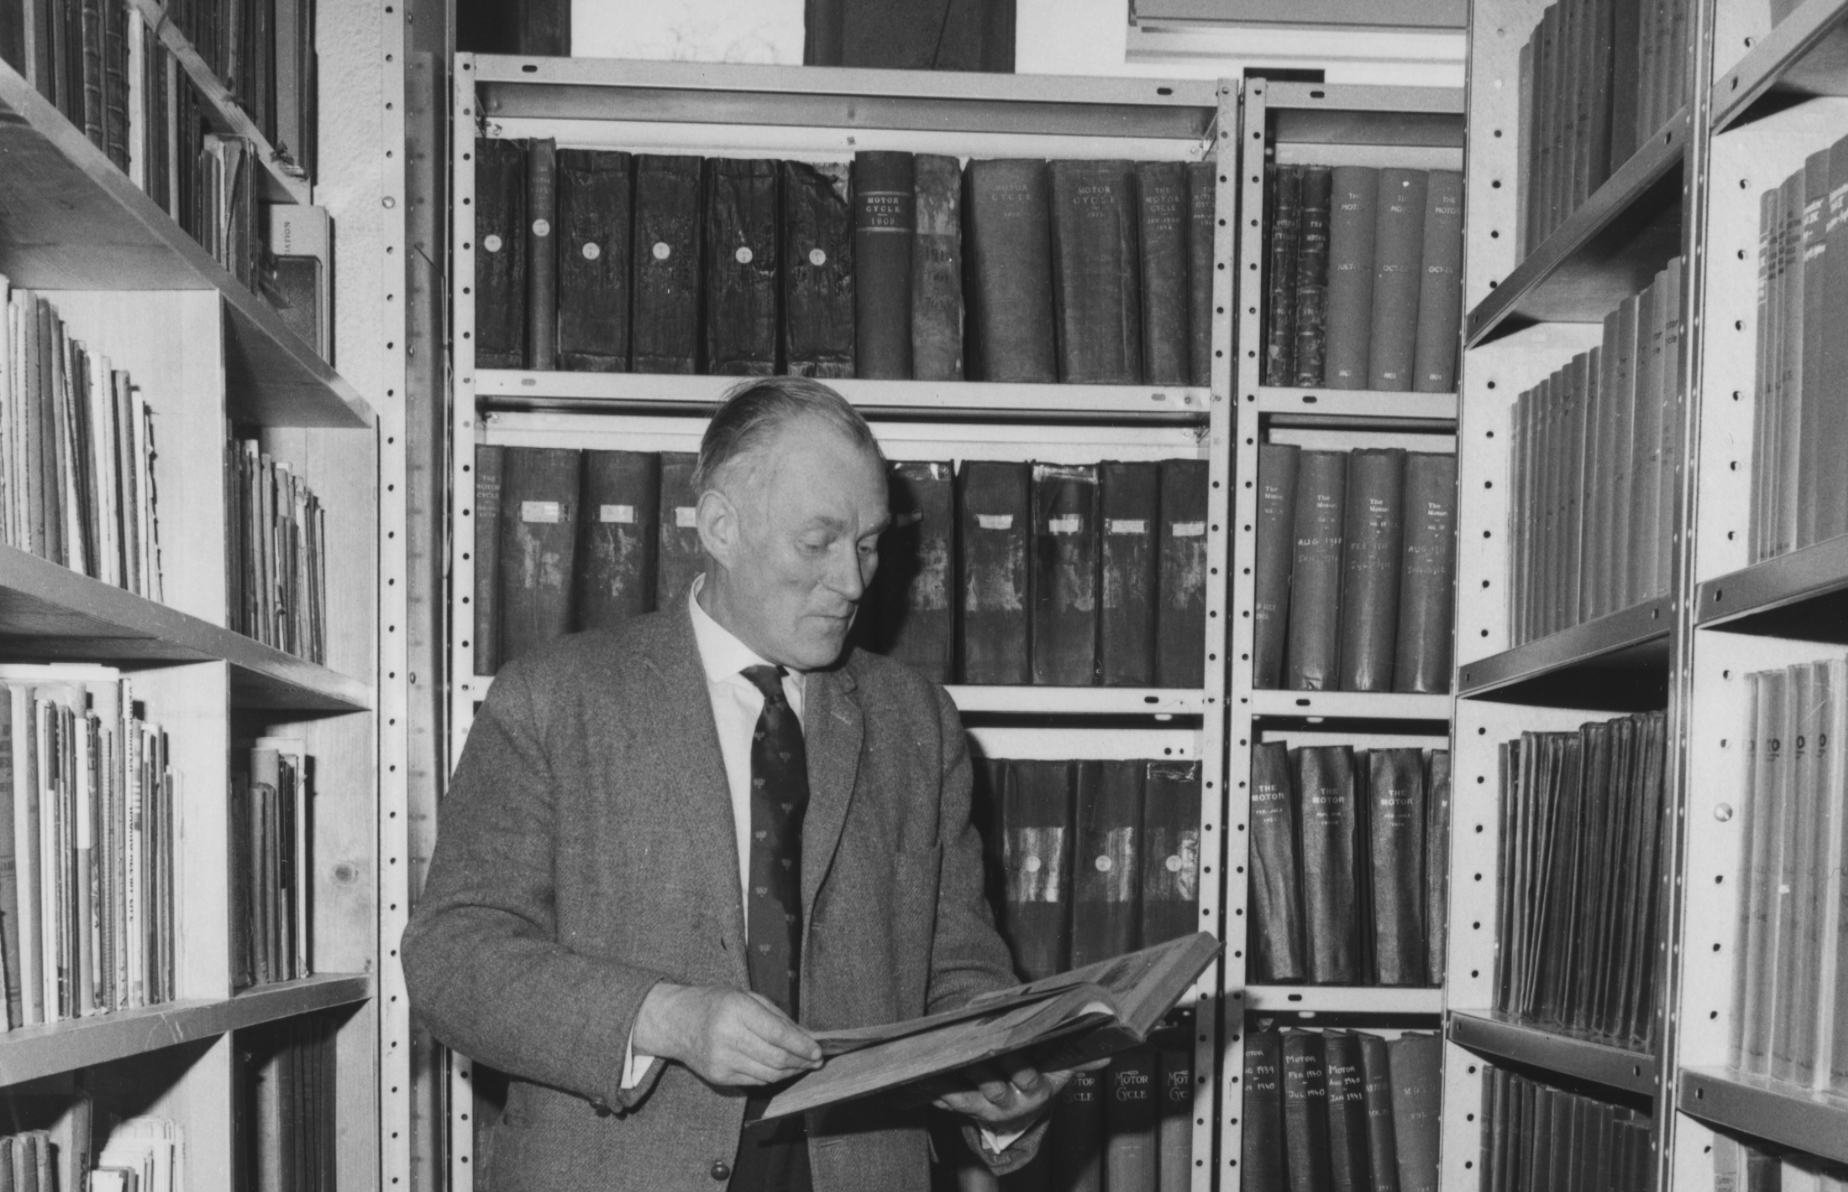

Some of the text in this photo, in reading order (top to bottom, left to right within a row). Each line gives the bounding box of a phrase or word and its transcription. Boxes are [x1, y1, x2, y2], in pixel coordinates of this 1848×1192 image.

[1078, 185, 1111, 194] MOTOR
[991, 193, 1032, 201] CYCLE
[1073, 196, 1116, 205] CYCLE
[865, 205, 901, 213] CYCLE
[871, 217, 895, 226] 1909
[1297, 538, 1319, 546] AUG
[1251, 793, 1285, 802] MOTOR
[1388, 789, 1407, 797] THE
[1312, 796, 1345, 804] MOTOR
[1380, 798, 1413, 806] MOTOR
[1285, 1055, 1316, 1064] MOTOR
[1257, 1066, 1275, 1075] 1939
[1306, 1070, 1323, 1079] 1940
[1328, 1065, 1356, 1075] MOTOR
[1114, 1070, 1149, 1087] MOTOR
[1167, 1070, 1189, 1086] MOT
[1344, 1077, 1361, 1086] 1940
[1257, 1083, 1275, 1091] 1940
[1116, 1086, 1148, 1102] CYCLE
[1169, 1086, 1189, 1102] CYC
[1307, 1088, 1326, 1097] 1940
[1329, 1092, 1363, 1102] JAN 1941
